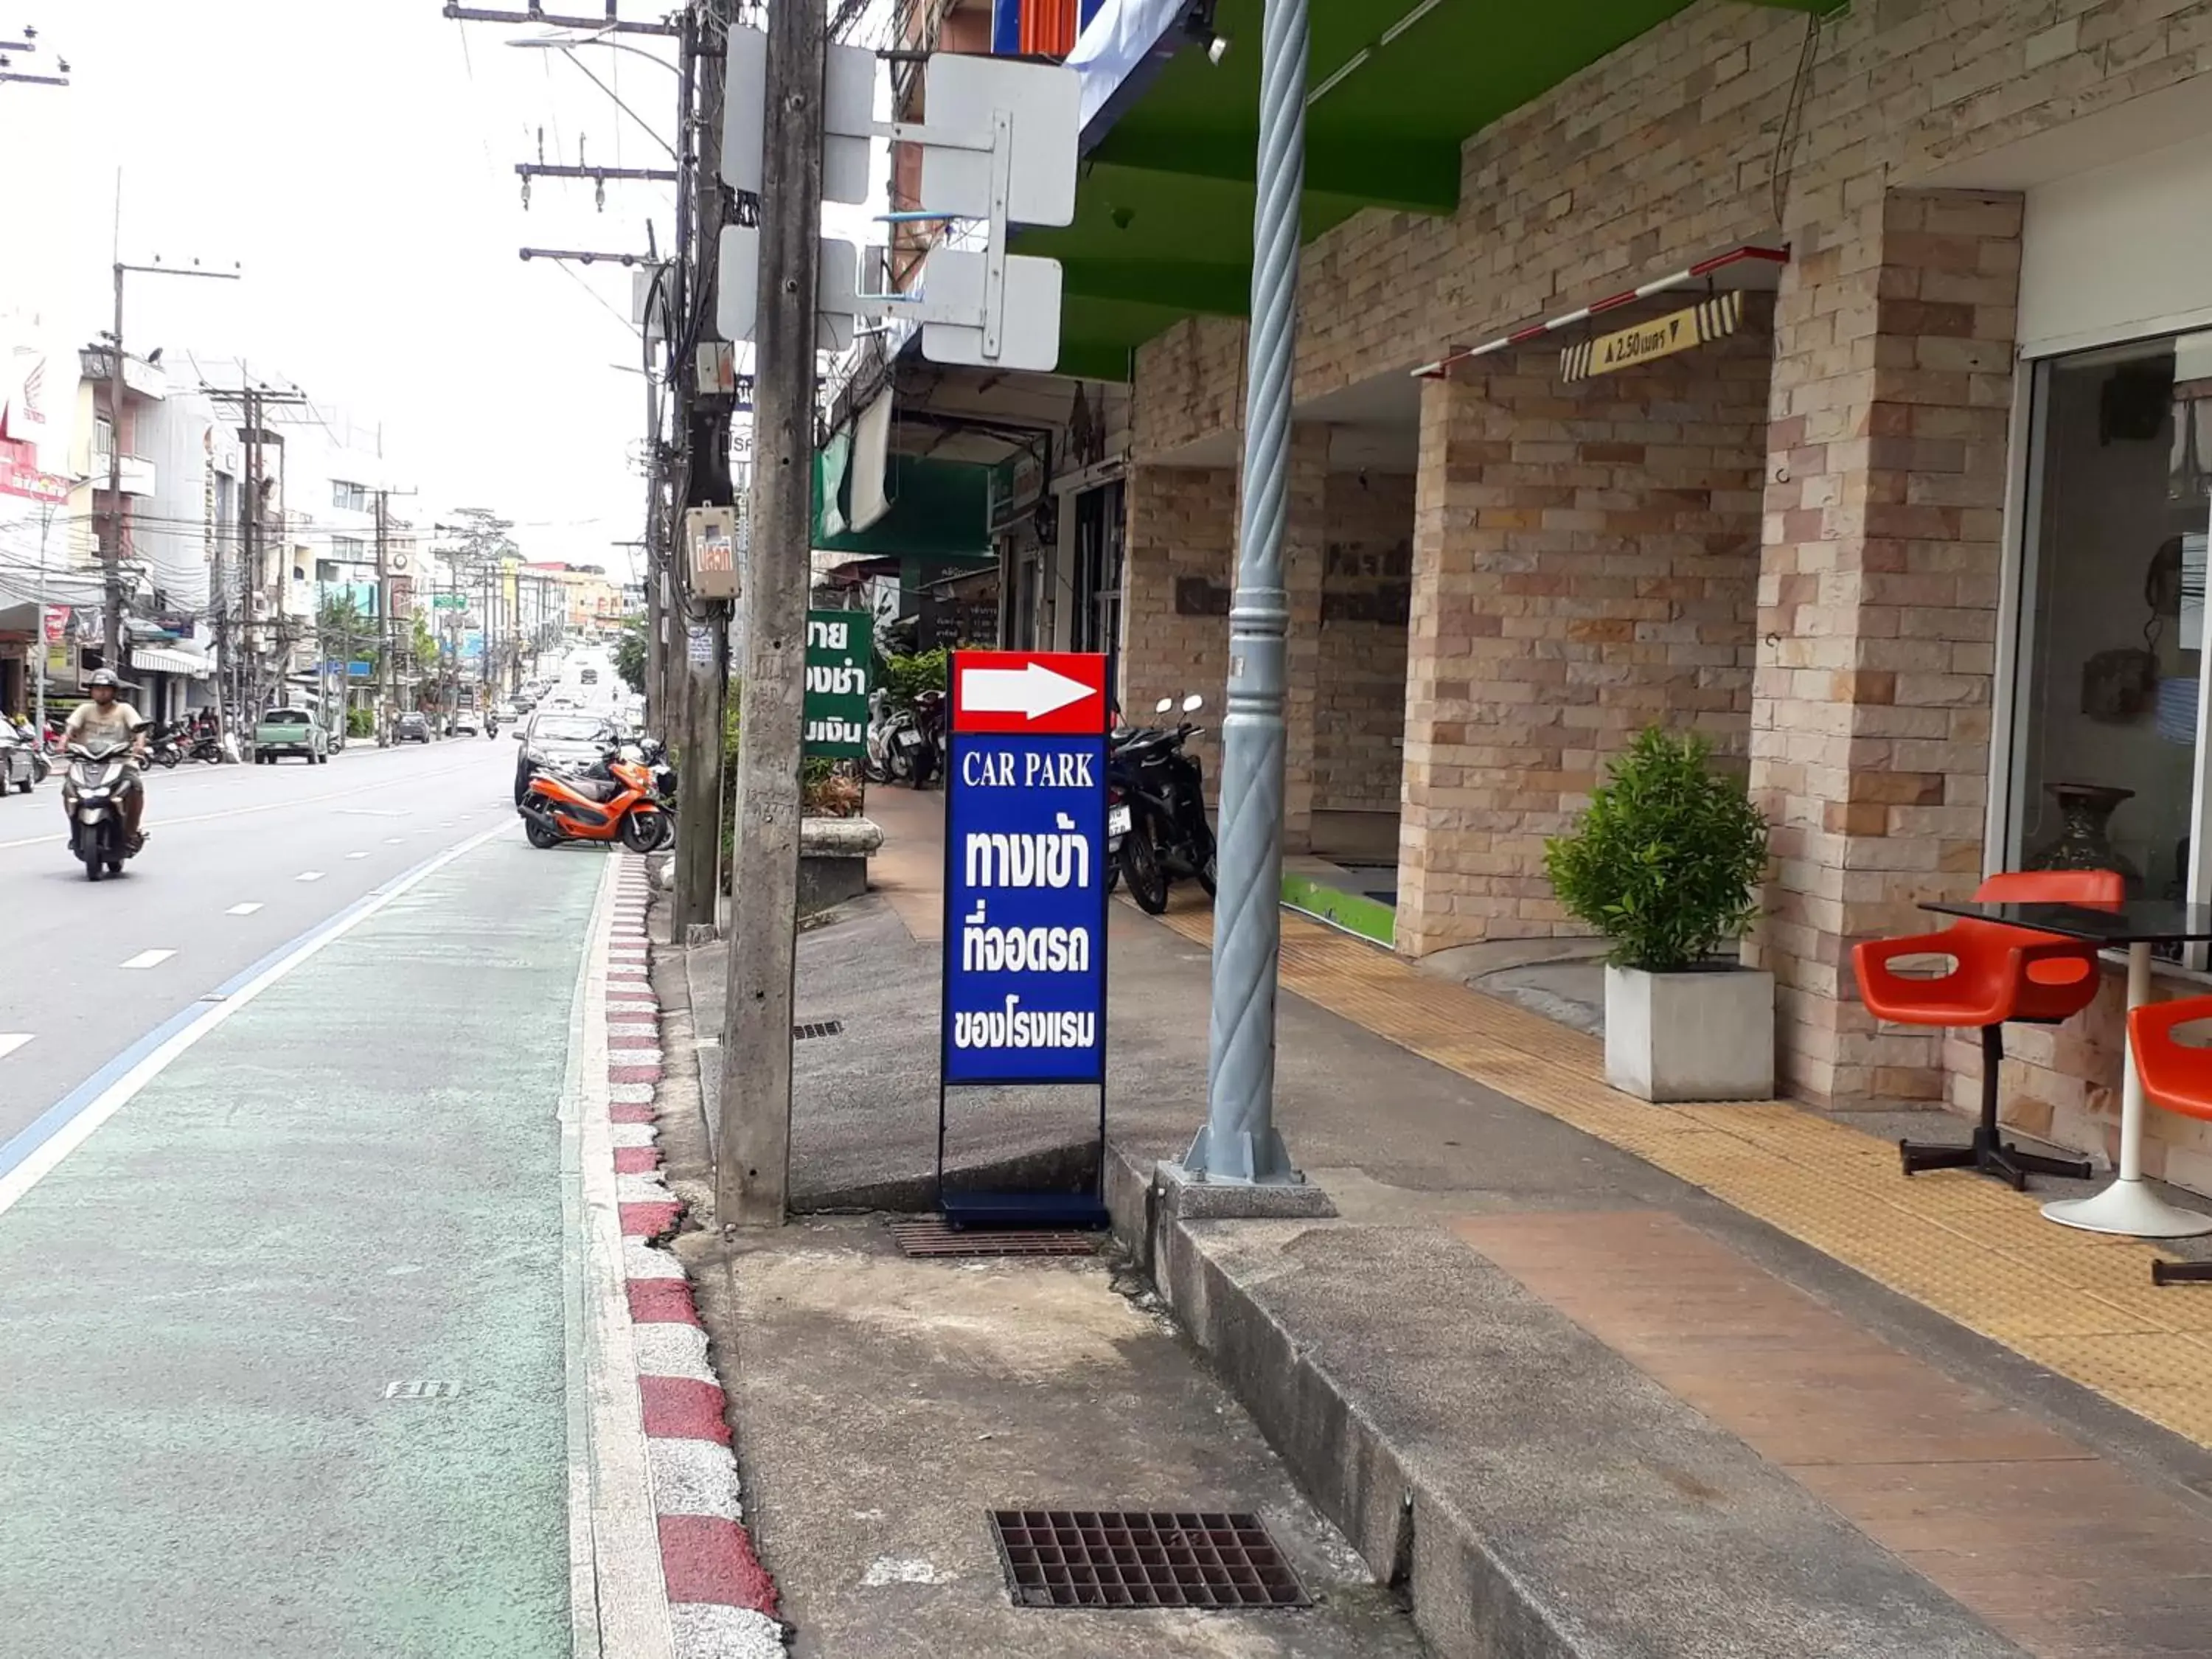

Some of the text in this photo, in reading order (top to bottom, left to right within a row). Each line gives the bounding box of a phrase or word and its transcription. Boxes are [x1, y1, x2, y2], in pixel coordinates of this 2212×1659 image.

[962, 751, 1094, 788] CAR PARK
[965, 811, 1089, 889] ทางเข้า
[962, 899, 1090, 972] ที่จอดรถ
[955, 994, 1095, 1048] ของโรงแรม
